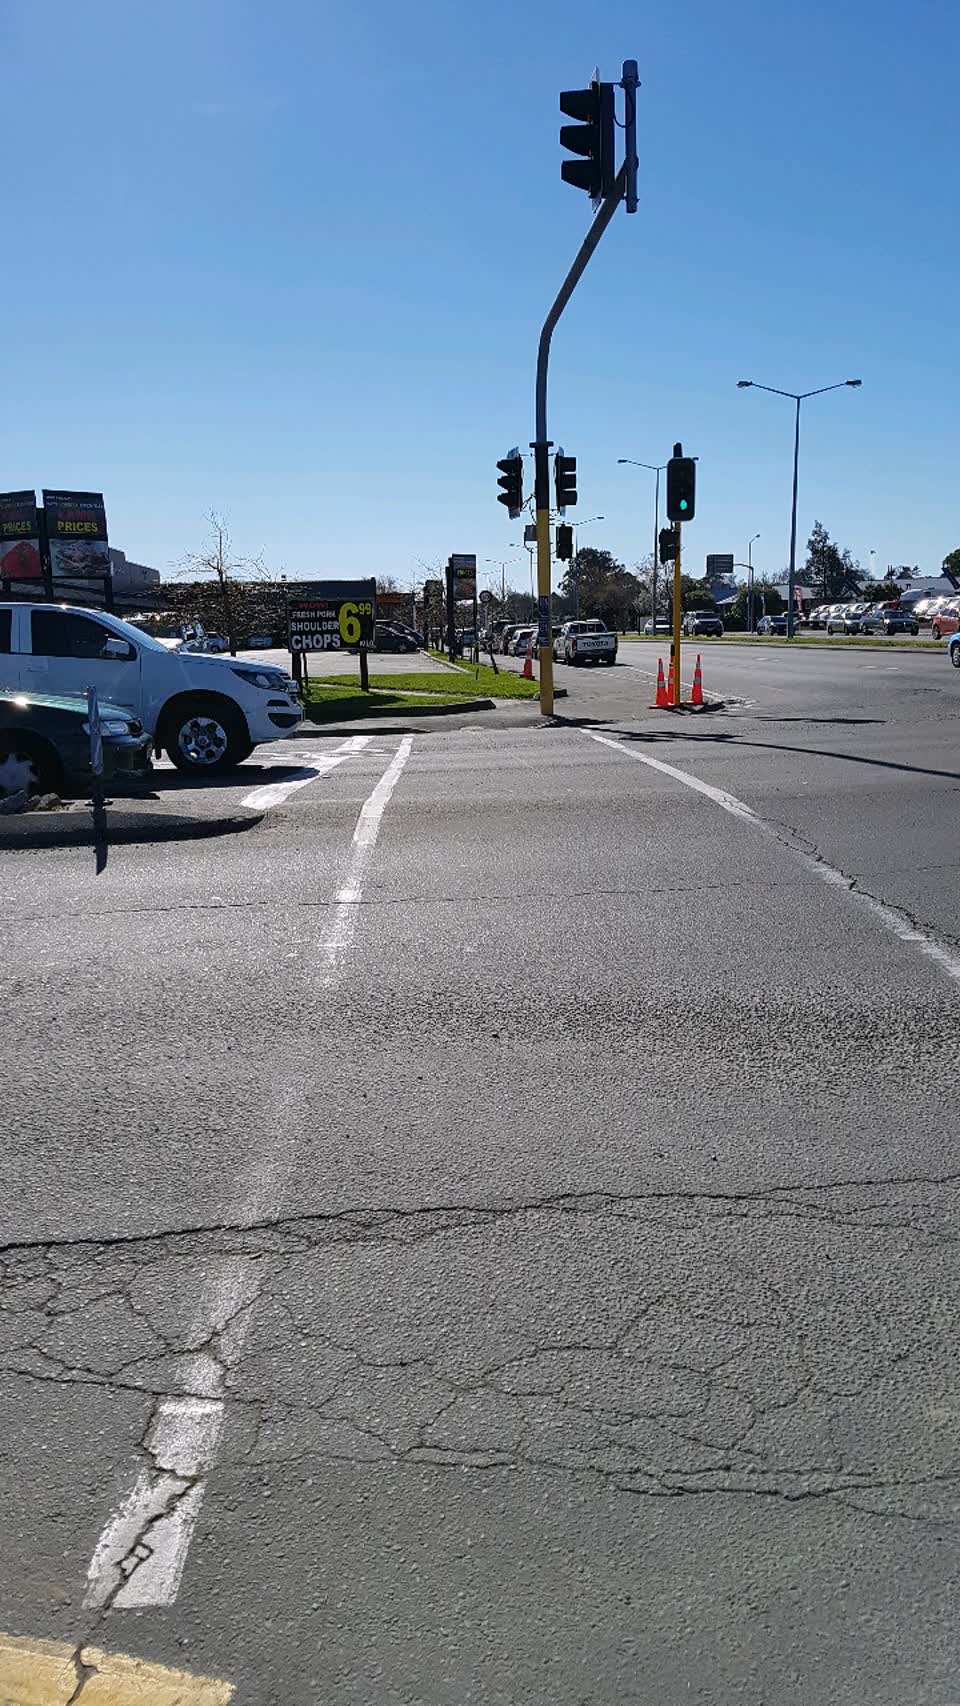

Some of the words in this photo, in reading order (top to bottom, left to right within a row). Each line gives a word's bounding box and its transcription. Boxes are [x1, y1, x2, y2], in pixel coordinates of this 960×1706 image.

[3, 520, 32, 533] PRICES
[57, 521, 98, 532] PRICES
[291, 621, 340, 631] SHOULDER
[291, 634, 341, 650] CHOPS
